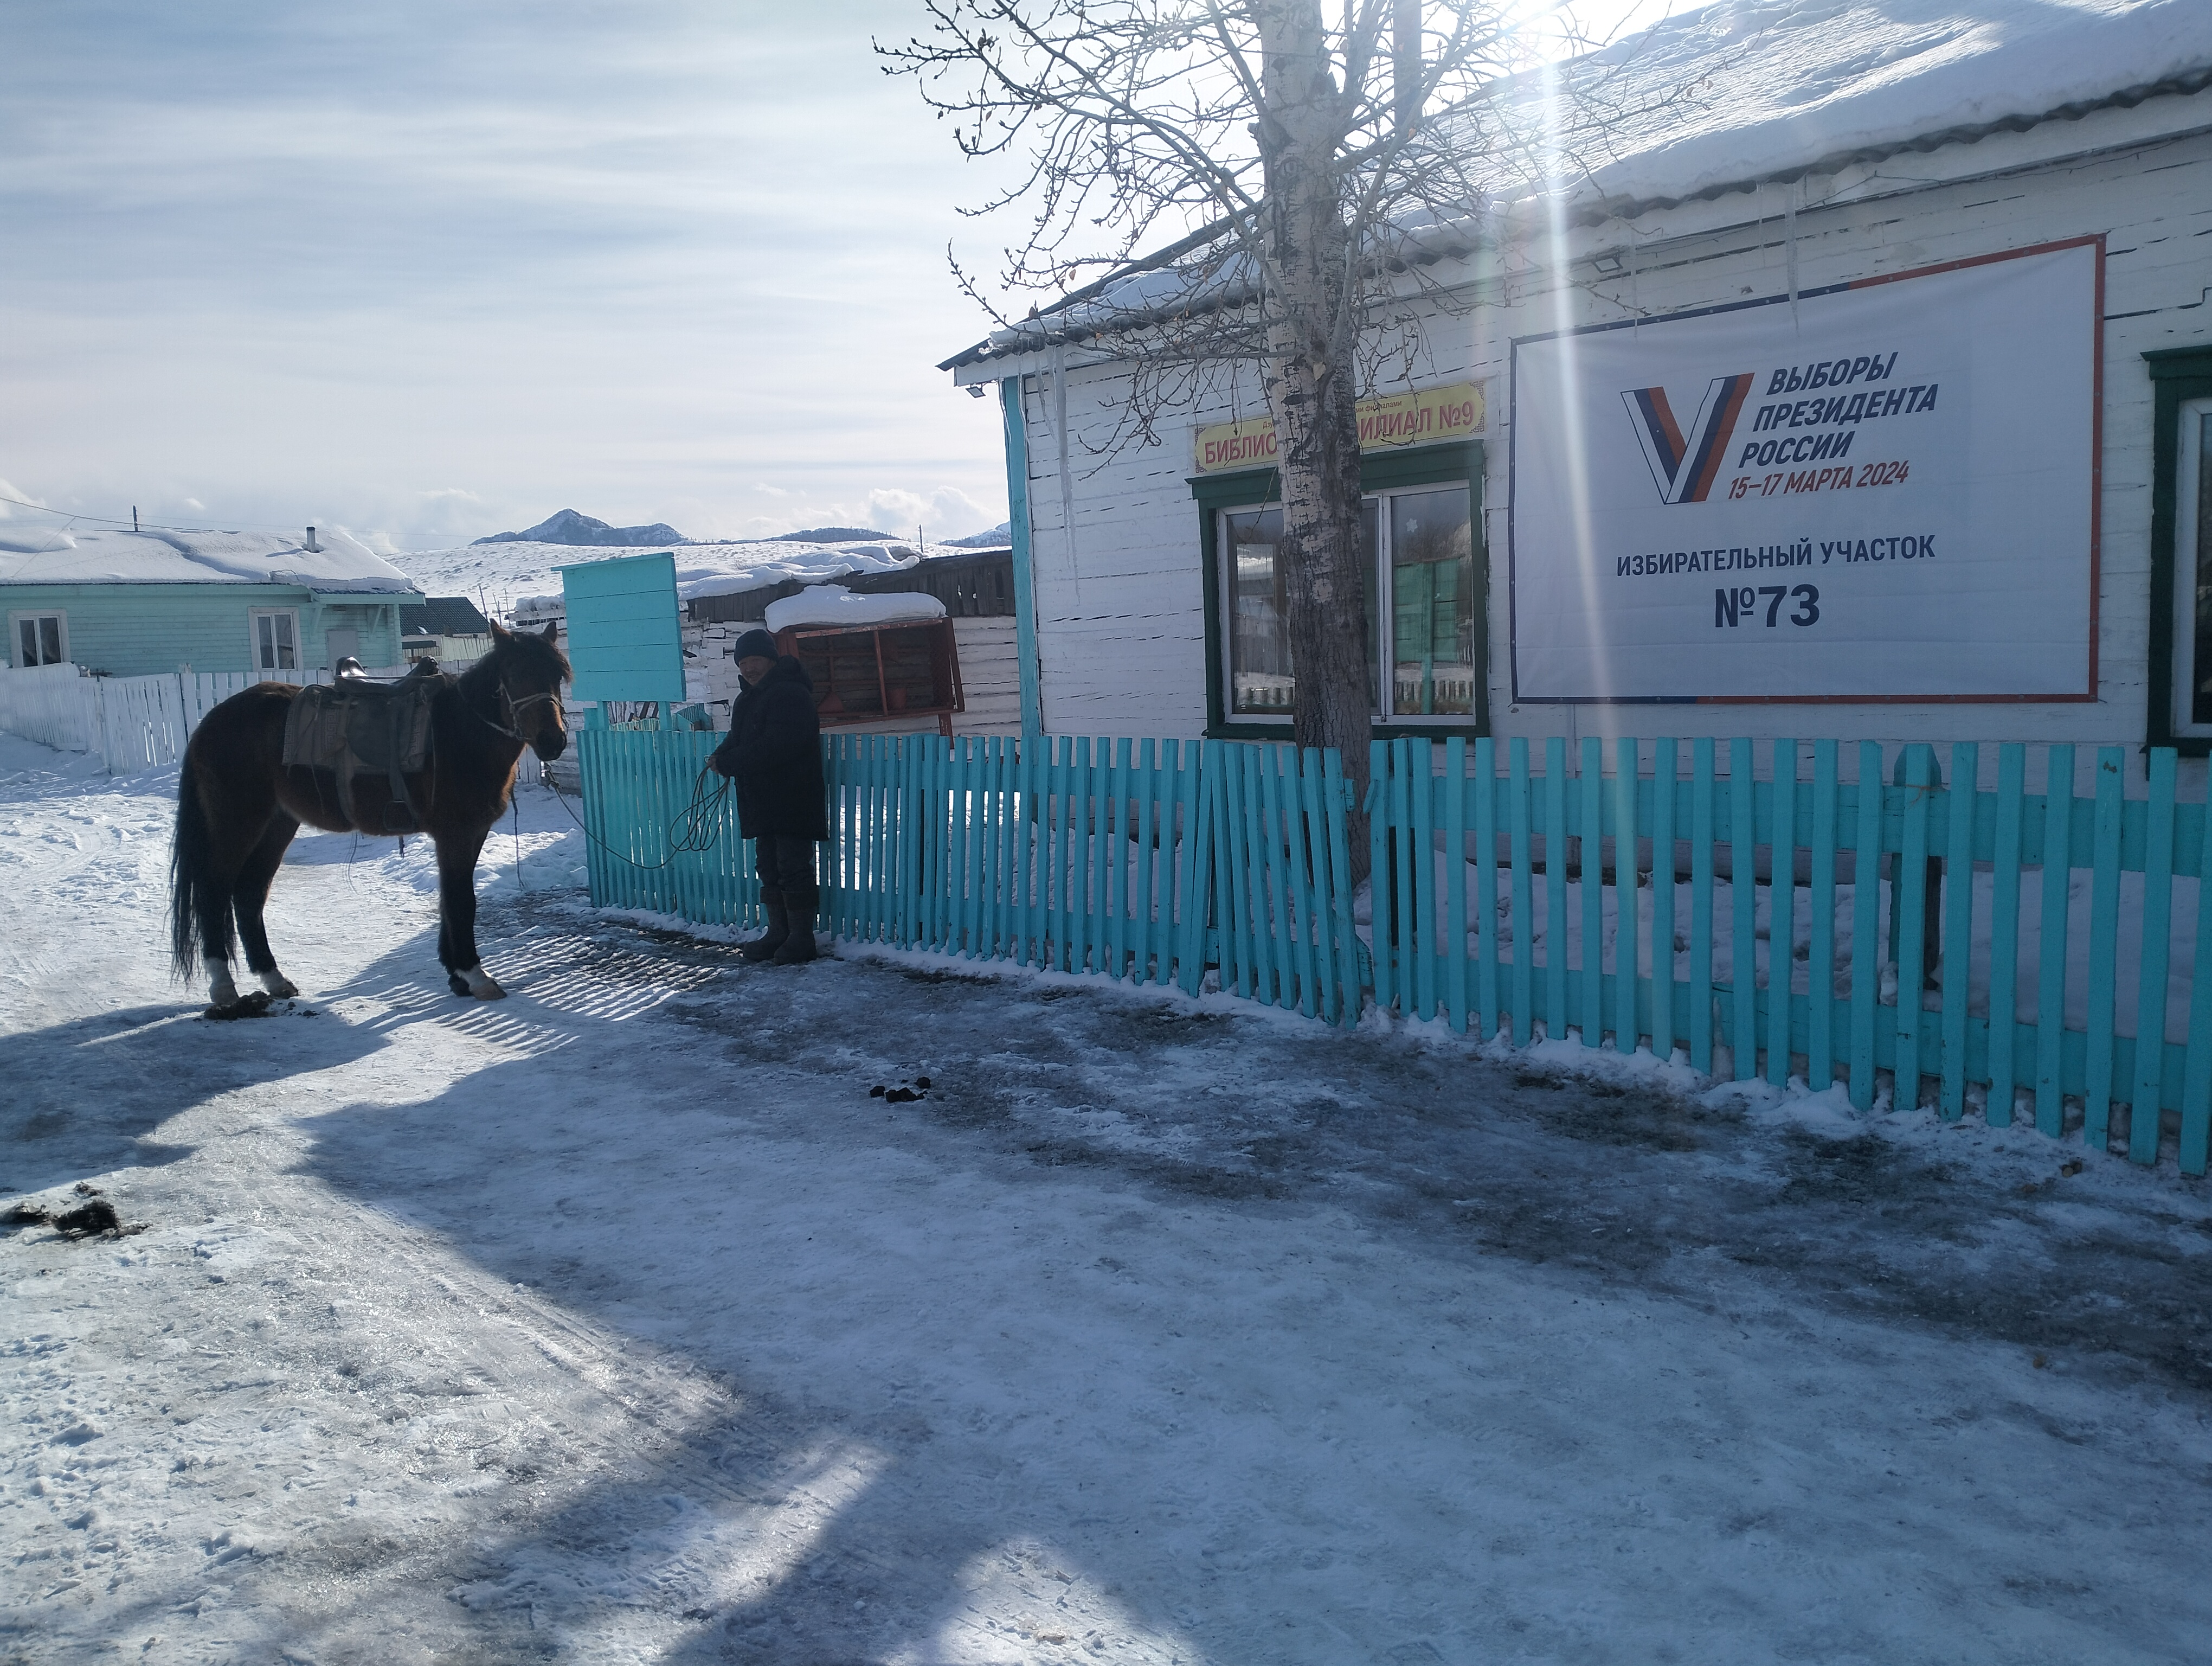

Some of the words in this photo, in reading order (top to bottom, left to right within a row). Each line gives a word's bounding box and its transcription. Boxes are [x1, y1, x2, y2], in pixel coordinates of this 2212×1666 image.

[1766, 351, 1899, 395] ВЫБОРЫ
[1752, 383, 1939, 432] ПРЕЗИДЕНТА
[1205, 432, 1278, 464] БИБЛИО
[1356, 407, 1431, 441] ИЛИАЛ
[1439, 401, 1474, 430] №9
[1738, 431, 1856, 469] РОССИИ
[1783, 465, 1854, 494] МАРТА
[1855, 460, 1909, 488] 2024
[1617, 537, 1812, 576] ИЗБИРАТЕЛЬНЫЙ
[1819, 534, 1936, 565] УЧАСТОК
[1714, 584, 1820, 628] №73
